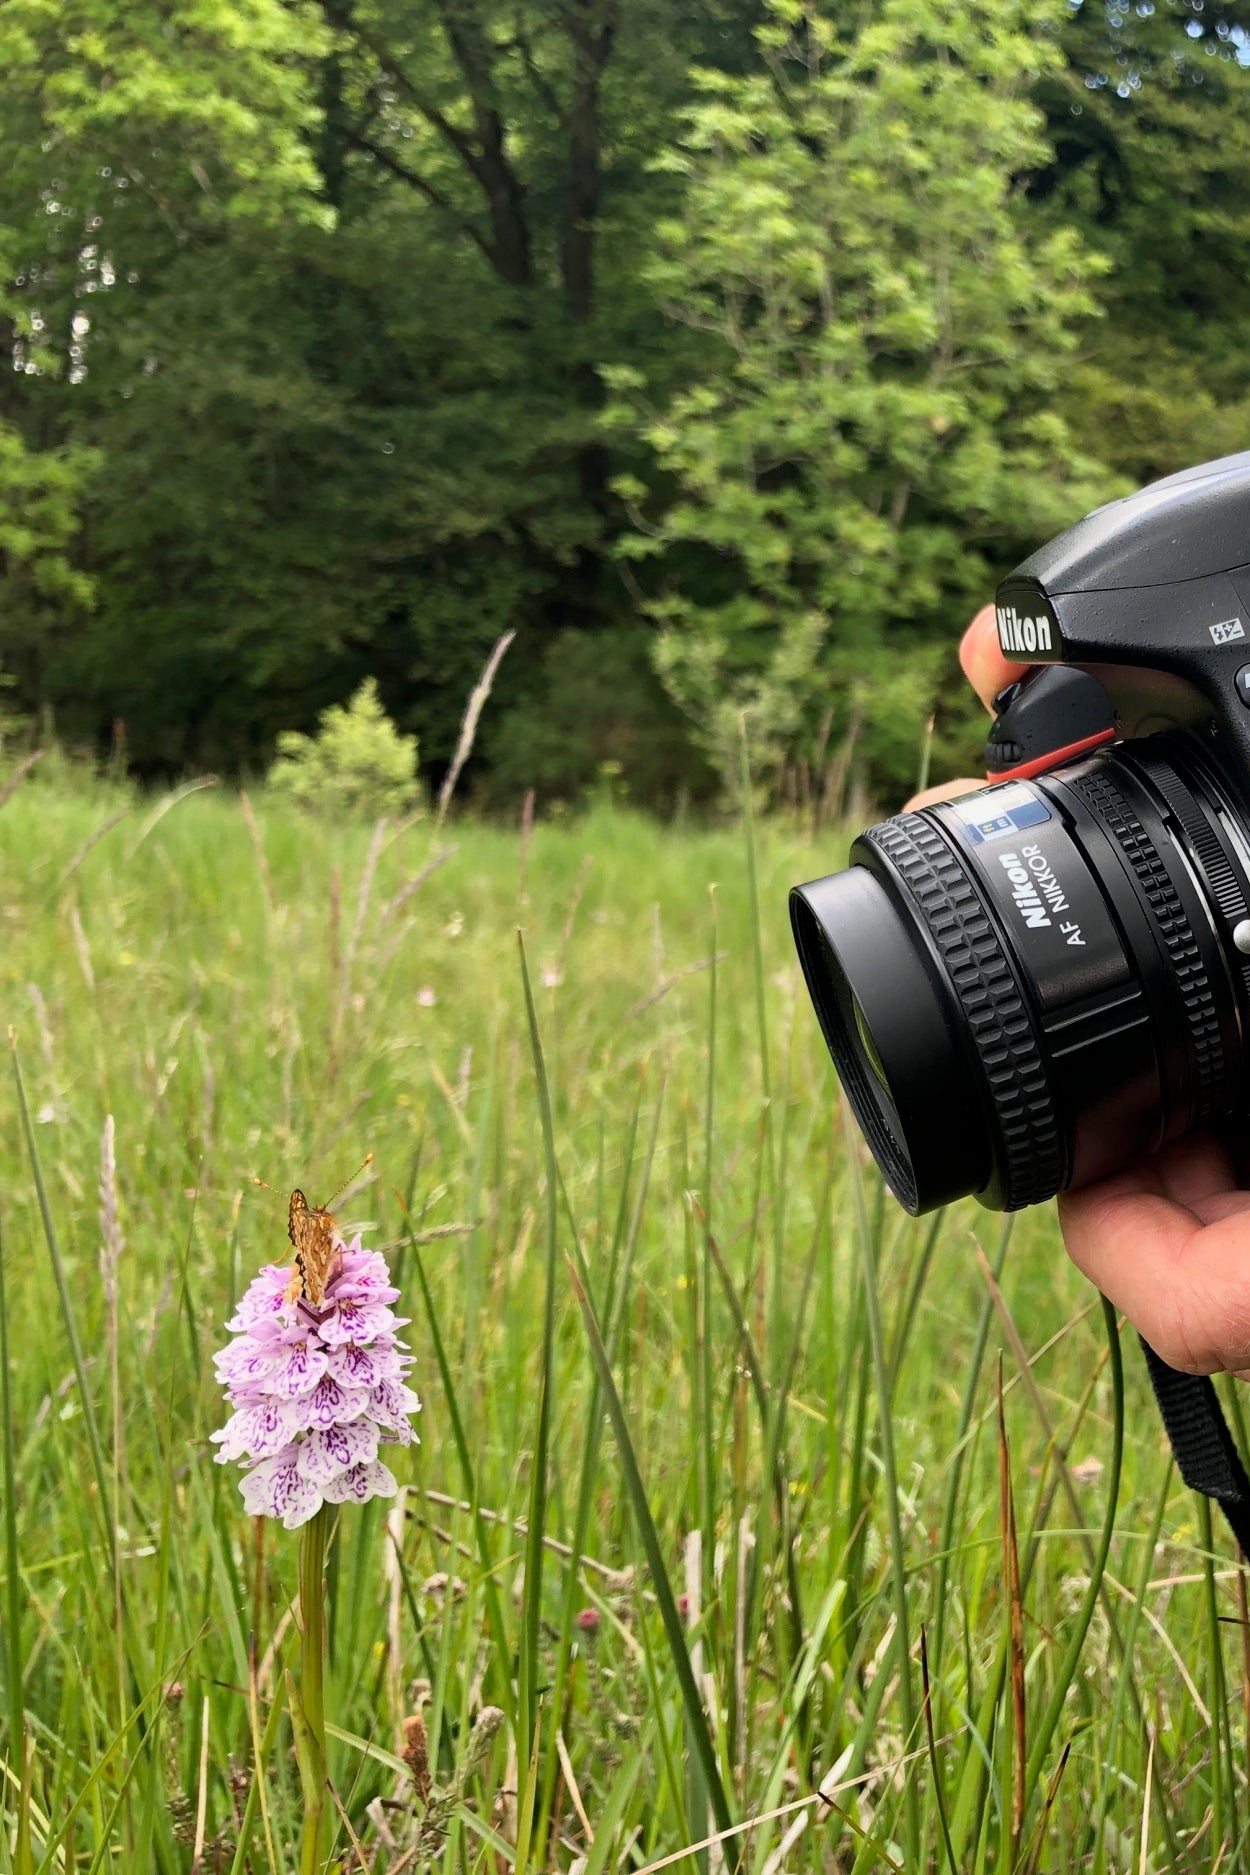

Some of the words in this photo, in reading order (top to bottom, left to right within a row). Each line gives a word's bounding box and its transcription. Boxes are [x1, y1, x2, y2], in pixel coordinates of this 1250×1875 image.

[997, 607, 1053, 652] Nikon
[999, 853, 1051, 928] Nikon
[1022, 844, 1069, 913] NIKKOR
[1059, 921, 1086, 946] AF
